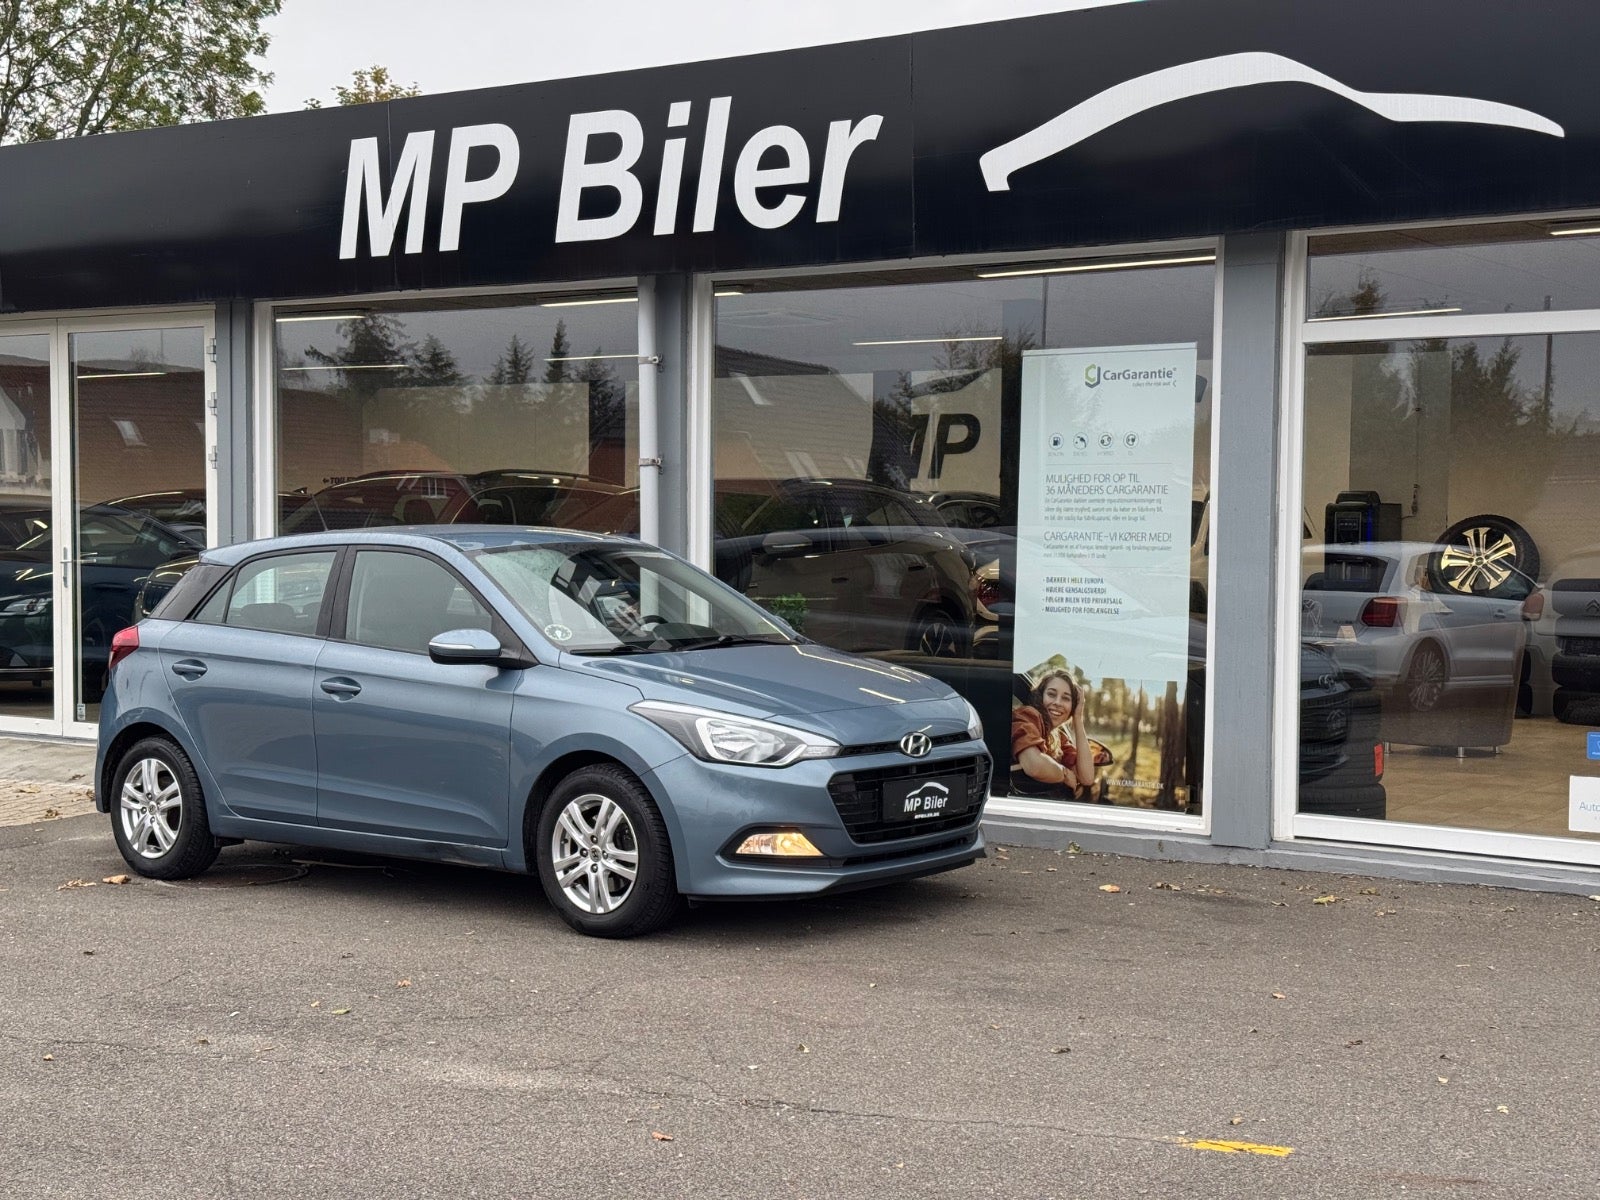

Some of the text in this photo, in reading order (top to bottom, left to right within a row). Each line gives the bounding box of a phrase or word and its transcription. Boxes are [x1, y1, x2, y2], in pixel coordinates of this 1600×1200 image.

[339, 96, 883, 260] MP Biler
[1103, 367, 1174, 381] CarGarantie
[1045, 473, 1140, 484] MULIGHED FOR OP TIL
[1045, 483, 1169, 495] 36 MÅNEDERS CARGARANTIE
[1119, 531, 1147, 542] KØRER
[1149, 532, 1172, 543] MED!
[1072, 606, 1083, 614] FOR
[904, 795, 949, 813] MP Biler
